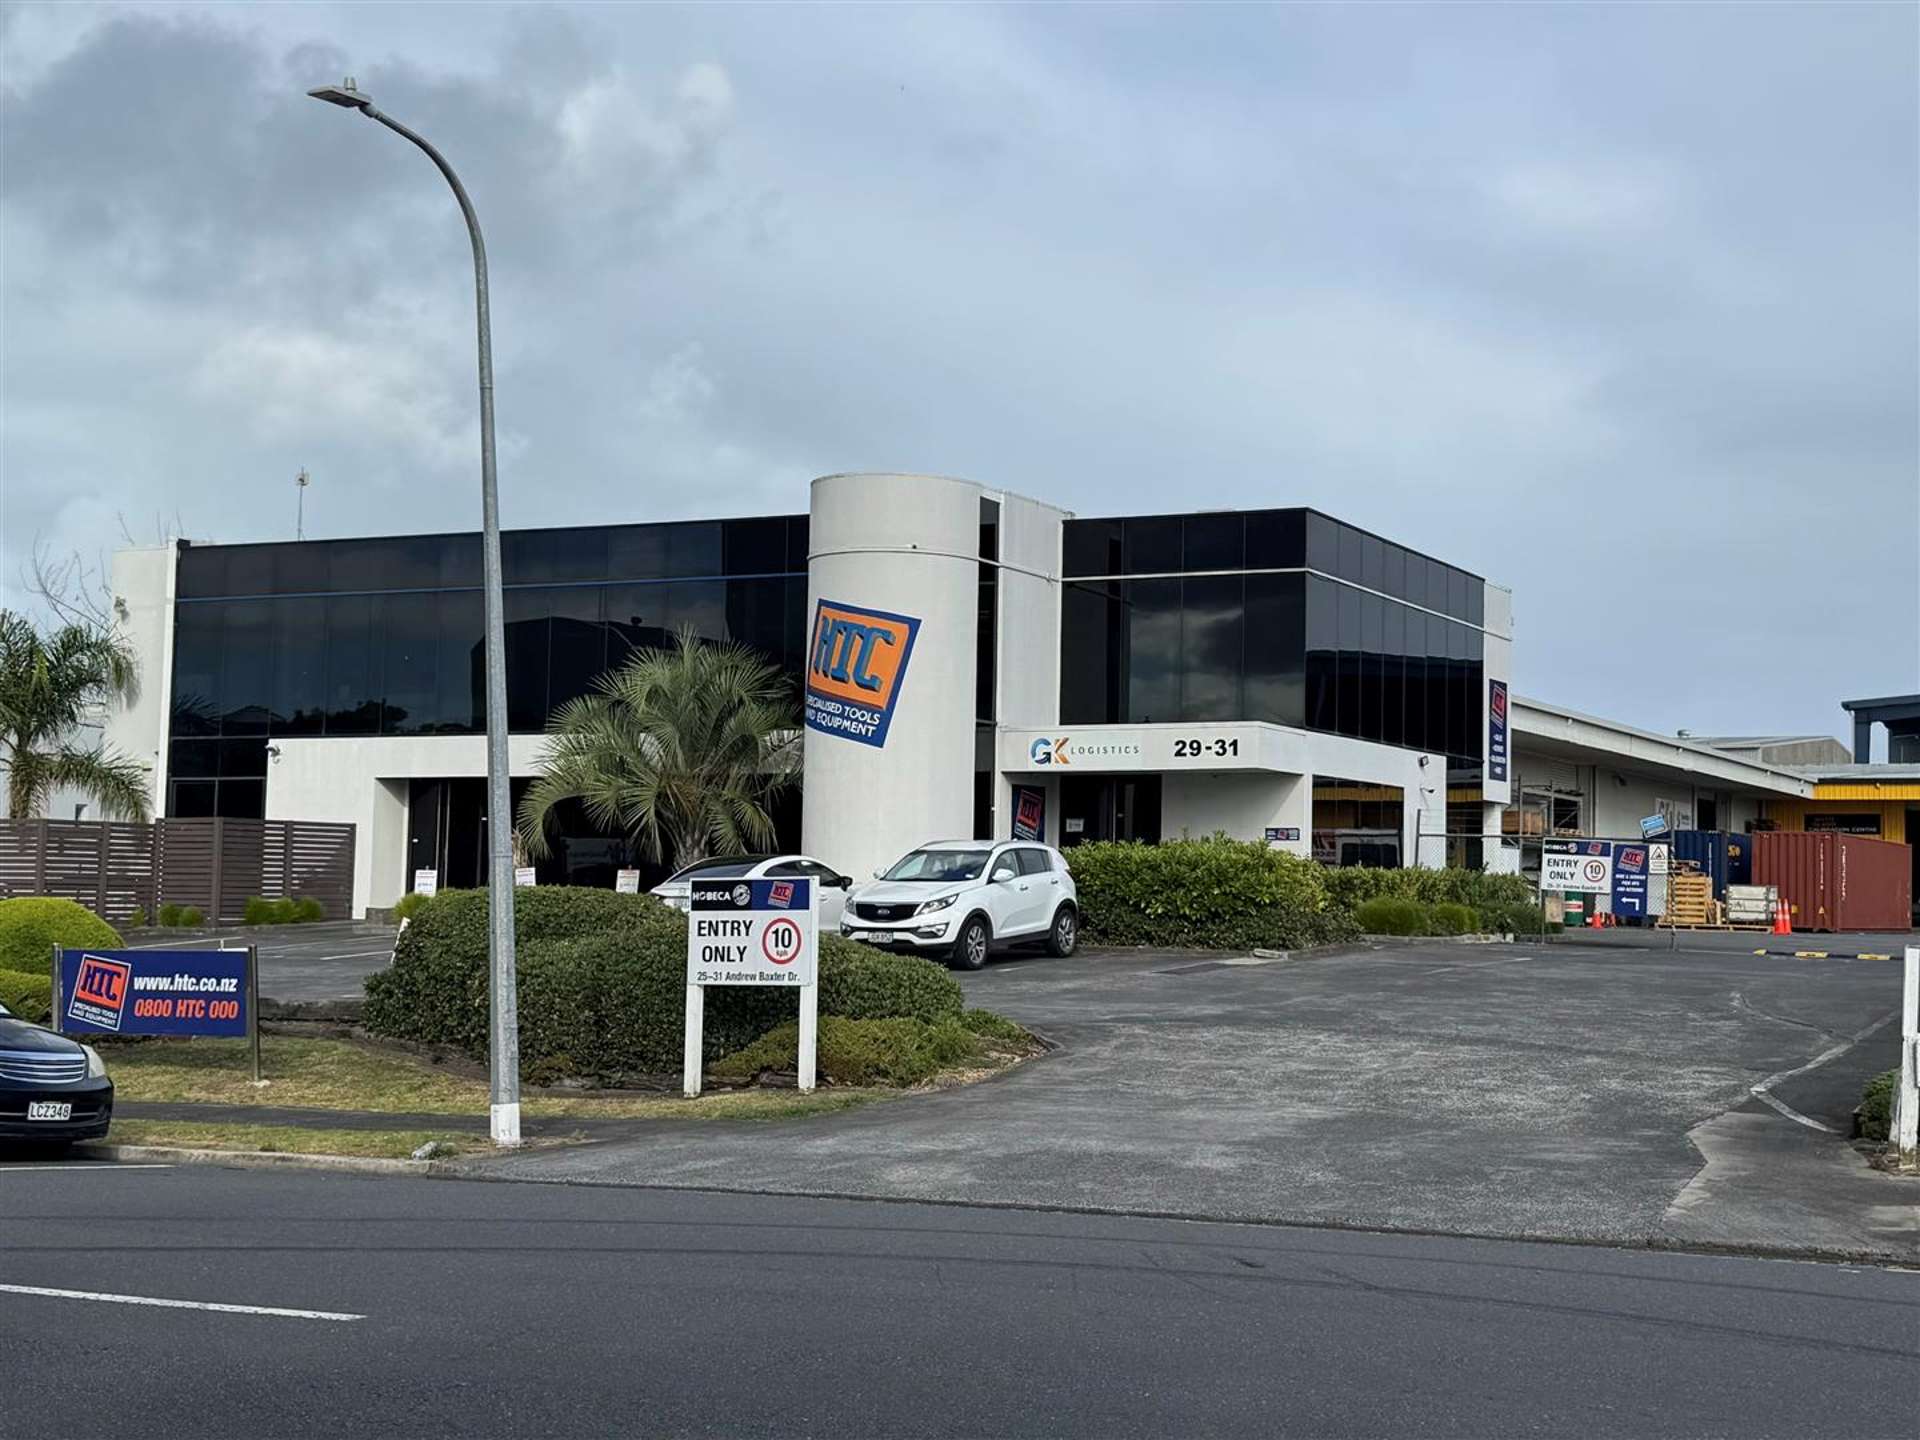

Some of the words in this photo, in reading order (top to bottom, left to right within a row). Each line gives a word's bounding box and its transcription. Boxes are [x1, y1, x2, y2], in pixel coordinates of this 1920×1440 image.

[813, 618, 896, 693] HTC
[817, 712, 876, 738] EQUIPMENT
[844, 706, 880, 726] TOOLS
[1030, 737, 1070, 765] GK
[1071, 745, 1140, 755] LOGISTICS
[1174, 739, 1239, 757] 29-31
[1547, 858, 1579, 869] ENTRY
[1589, 864, 1600, 875] 10
[1549, 871, 1576, 880] ONLY
[692, 891, 732, 901] HOBECA
[697, 920, 753, 937] ENTRY
[771, 927, 792, 949] 10
[702, 945, 748, 963] ONLY
[81, 964, 121, 1001] HTC
[133, 973, 238, 992] www.htc.co.nz
[725, 970, 757, 982] Andrew
[759, 970, 786, 982] Baxter
[787, 971, 801, 982] Dr.
[134, 999, 172, 1017] 0800
[176, 999, 206, 1018] HTC
[208, 999, 239, 1019] 000
[30, 1104, 70, 1118] LCZ348
